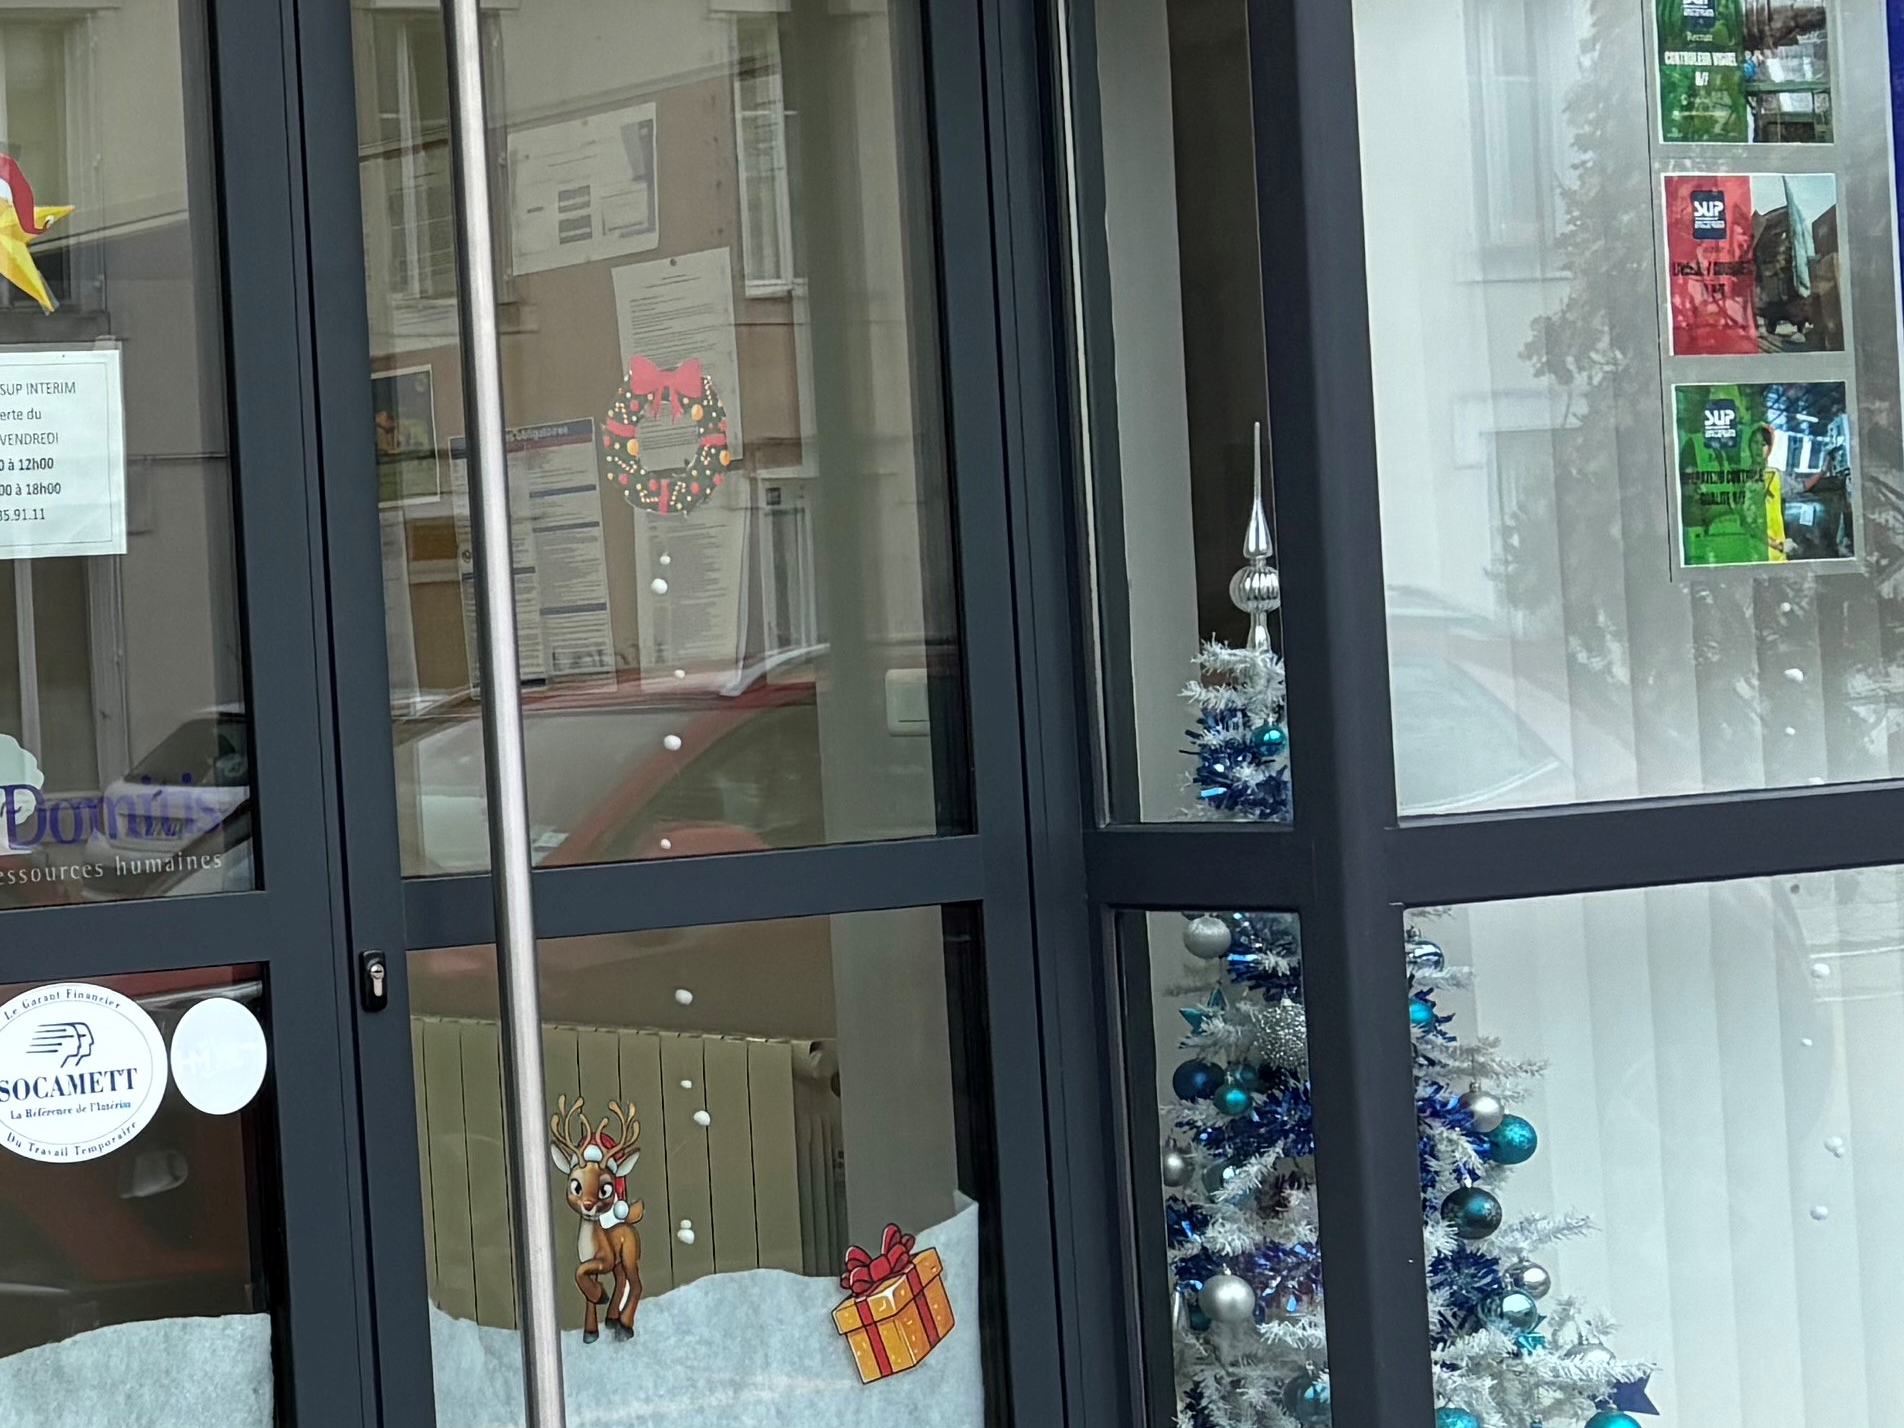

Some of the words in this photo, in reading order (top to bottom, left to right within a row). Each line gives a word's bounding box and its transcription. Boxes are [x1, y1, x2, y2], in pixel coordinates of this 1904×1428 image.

[1693, 200, 1724, 217] SUP
[0, 383, 23, 396] SUP
[26, 381, 76, 395] INTERIM
[26, 407, 42, 420] du
[1704, 409, 1735, 426] SUP
[8, 458, 15, 471] à
[18, 457, 54, 471] 12h00
[15, 484, 22, 496] à
[25, 482, 61, 495] 18h00
[115, 853, 222, 876] humaines
[4, 1008, 18, 1020] Le
[22, 991, 60, 1009] Garant
[66, 988, 121, 1009] Financier
[11, 1110, 22, 1120] La
[76, 1103, 86, 1113] de
[7, 1132, 22, 1149] Du
[28, 1141, 68, 1157] Travail
[75, 1122, 137, 1155] Temporaire
